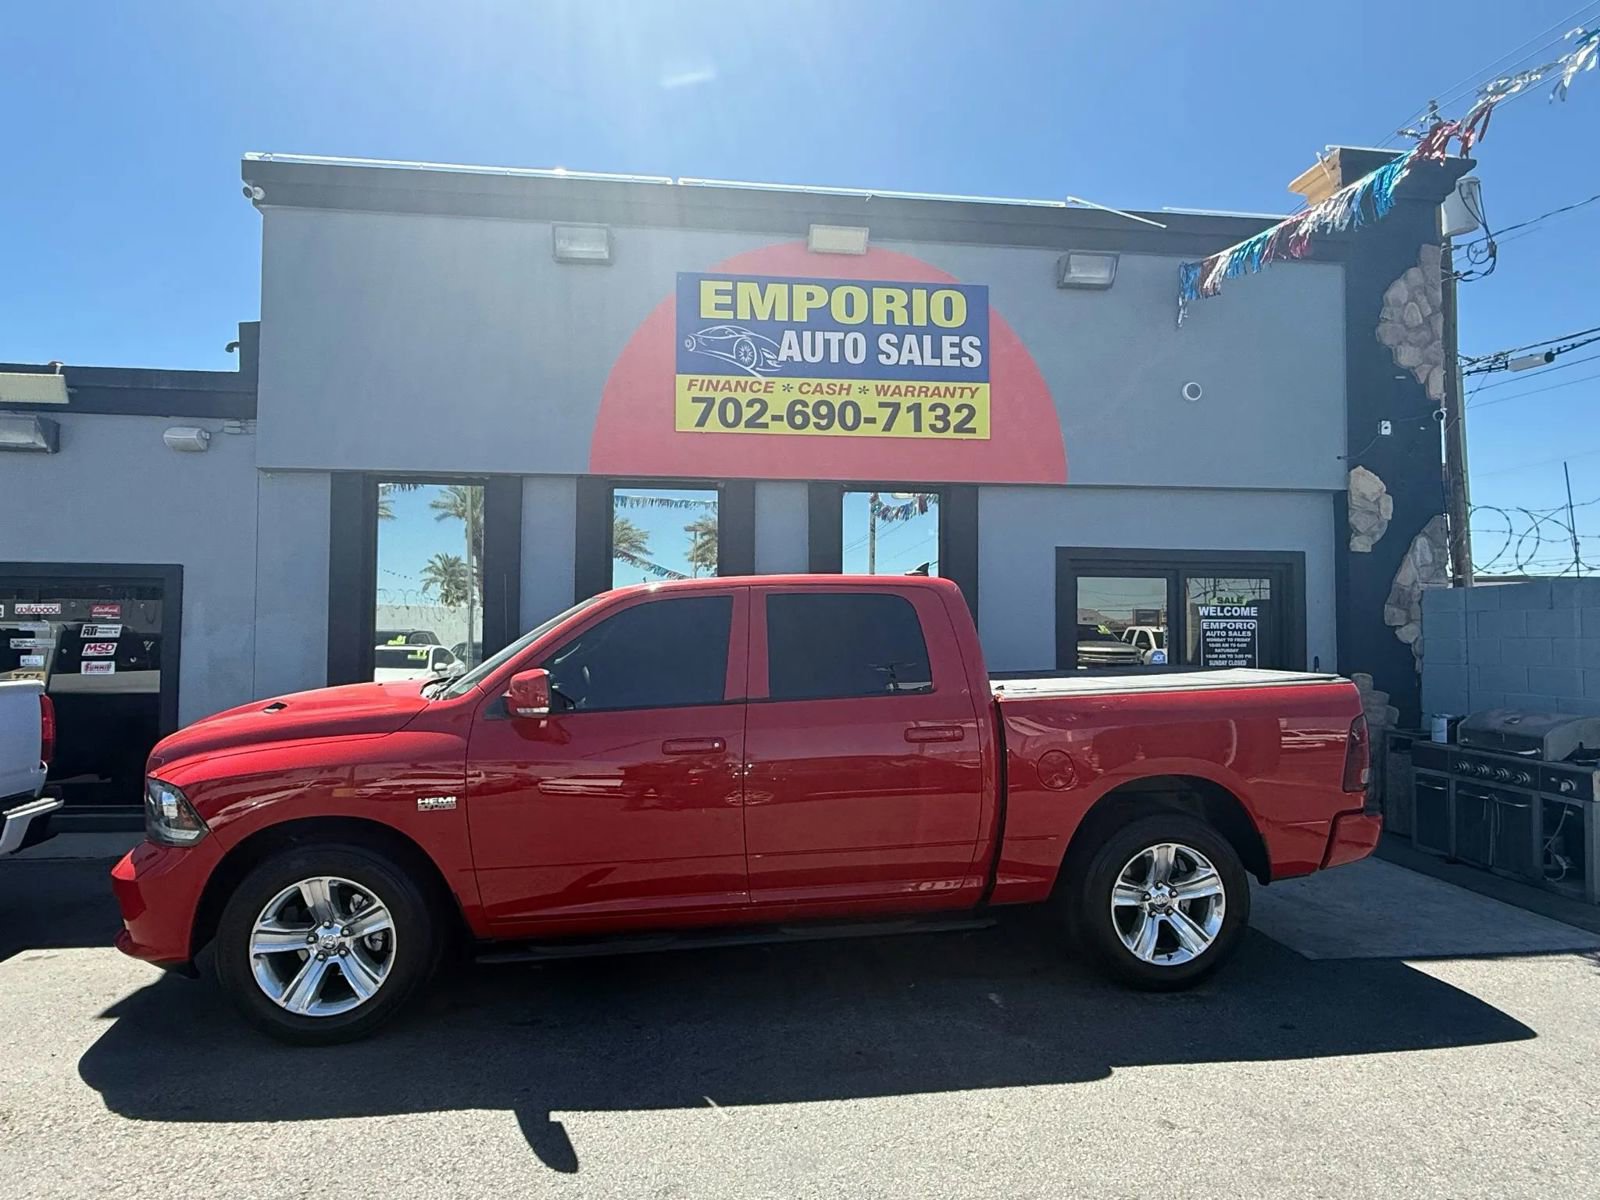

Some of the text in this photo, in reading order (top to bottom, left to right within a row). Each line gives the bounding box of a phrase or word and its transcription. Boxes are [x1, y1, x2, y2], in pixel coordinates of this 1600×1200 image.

[699, 279, 968, 329] EMPORIO
[778, 330, 983, 369] AUTO SALES
[686, 378, 980, 400] FINANCE CASH WARRANTY
[690, 396, 978, 435] 702-690-7132
[1216, 596, 1244, 605] SALE
[1198, 606, 1258, 616] WELCOME
[1202, 622, 1256, 630] EMPORIO
[85, 643, 115, 652] MSD
